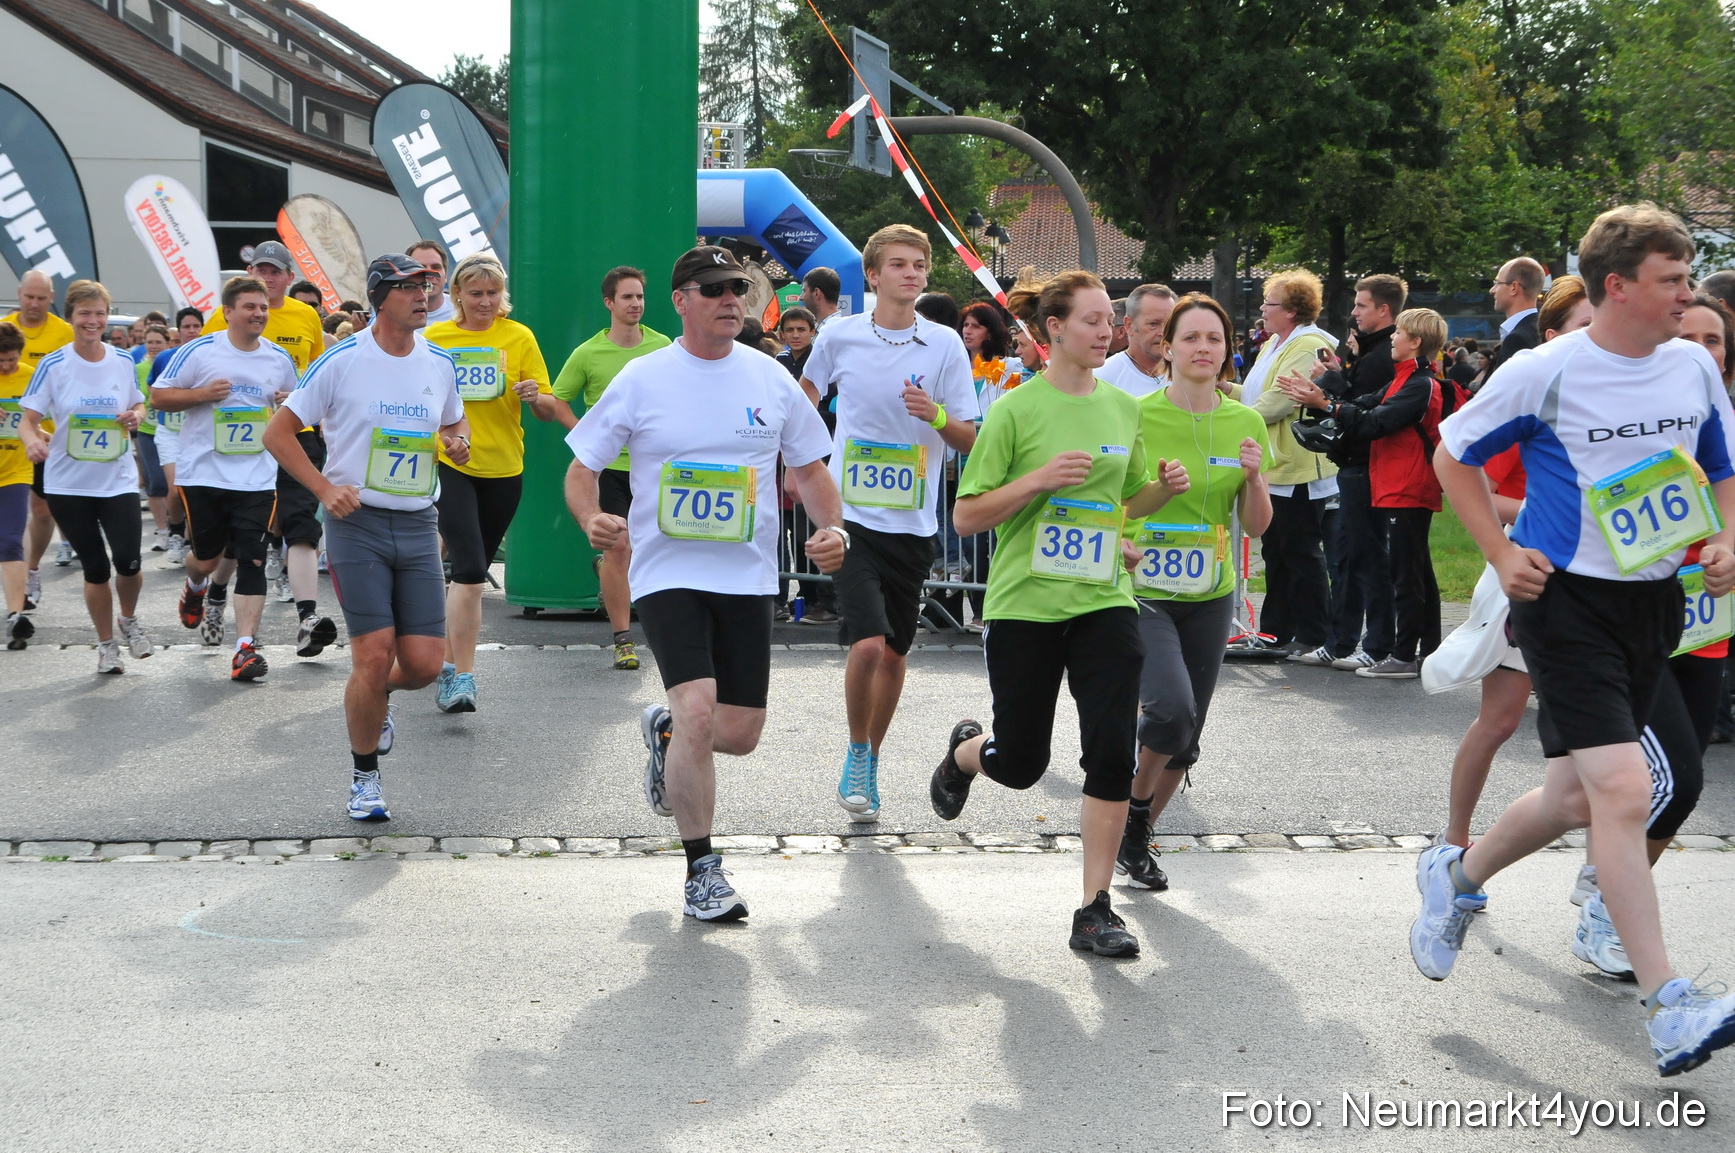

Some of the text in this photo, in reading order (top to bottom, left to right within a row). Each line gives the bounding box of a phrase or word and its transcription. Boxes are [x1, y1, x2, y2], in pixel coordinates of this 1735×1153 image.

[456, 366, 496, 386] 288
[230, 383, 263, 397] einloth
[80, 396, 118, 406] heinloth
[380, 401, 429, 418] heinloth
[226, 423, 253, 443] 72
[735, 428, 778, 436] KÜFNER
[1588, 415, 1698, 443] DELPHI
[81, 430, 108, 449] 74
[388, 451, 419, 479] 71
[383, 477, 406, 486] Robert
[847, 463, 913, 491] 1360
[670, 488, 735, 521] 705
[675, 519, 710, 529] Reinhold
[1611, 483, 1690, 546] 916
[1041, 525, 1103, 563] 381
[1639, 534, 1662, 549] Peter
[1054, 559, 1077, 570] Sonja
[1142, 548, 1204, 579] 380
[1146, 578, 1181, 587] Christine
